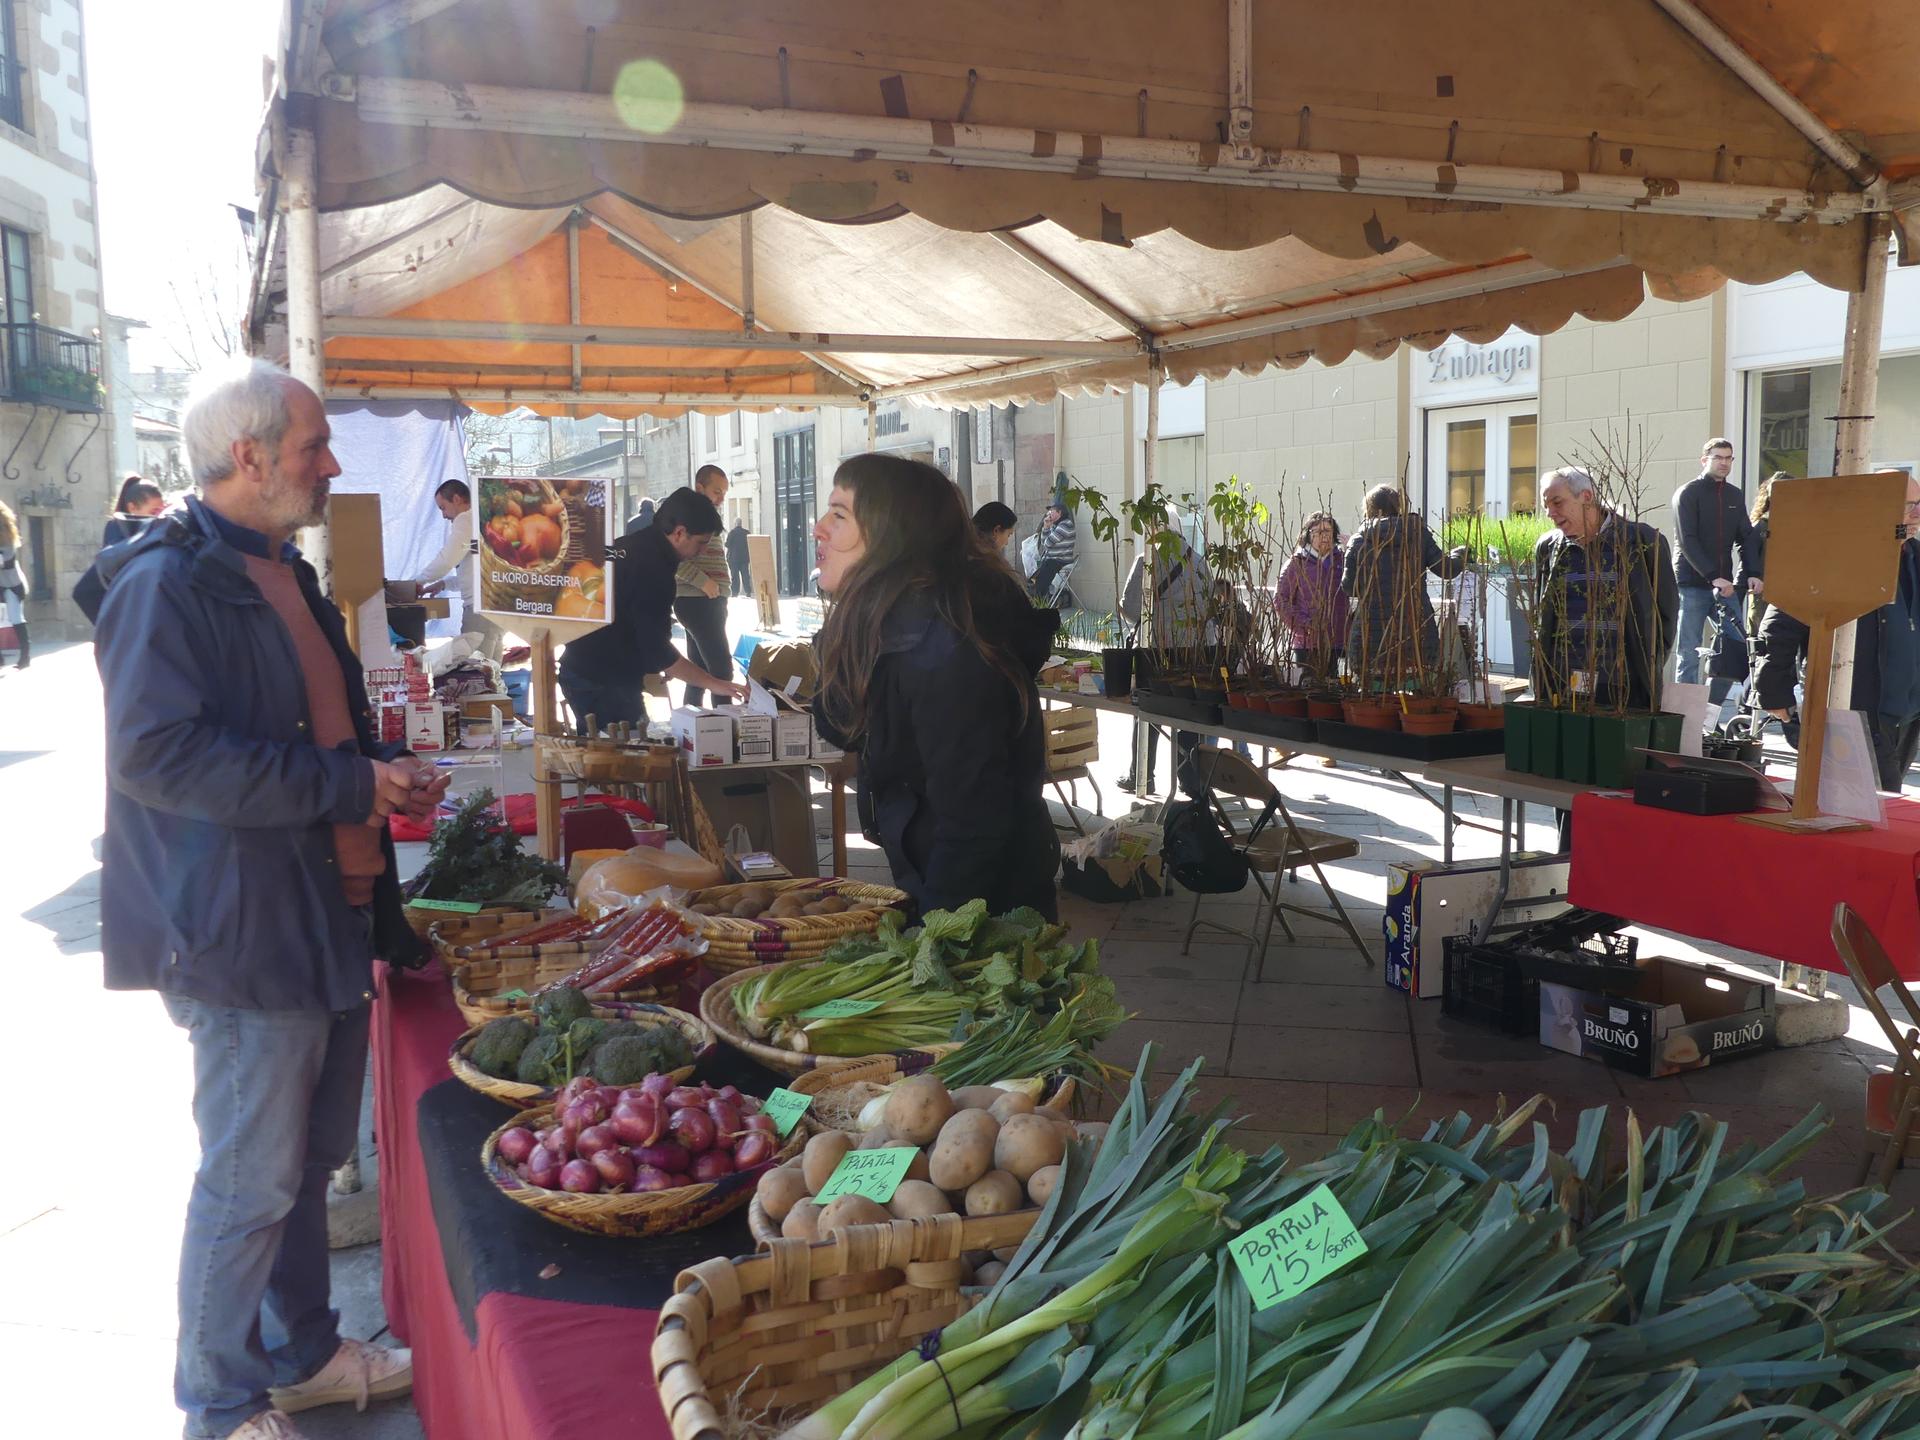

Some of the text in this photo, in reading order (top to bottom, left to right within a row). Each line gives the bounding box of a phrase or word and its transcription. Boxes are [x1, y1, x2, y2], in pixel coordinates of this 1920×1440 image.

[1428, 343, 1531, 383] Zubiaga
[491, 571, 580, 588] ELKORO BASERRIA
[516, 598, 553, 615] Bergara
[1401, 905, 1411, 965] Aranda
[1584, 1019, 1639, 1049] BRUÑÓ
[1712, 1019, 1764, 1050] BRUÑÓ
